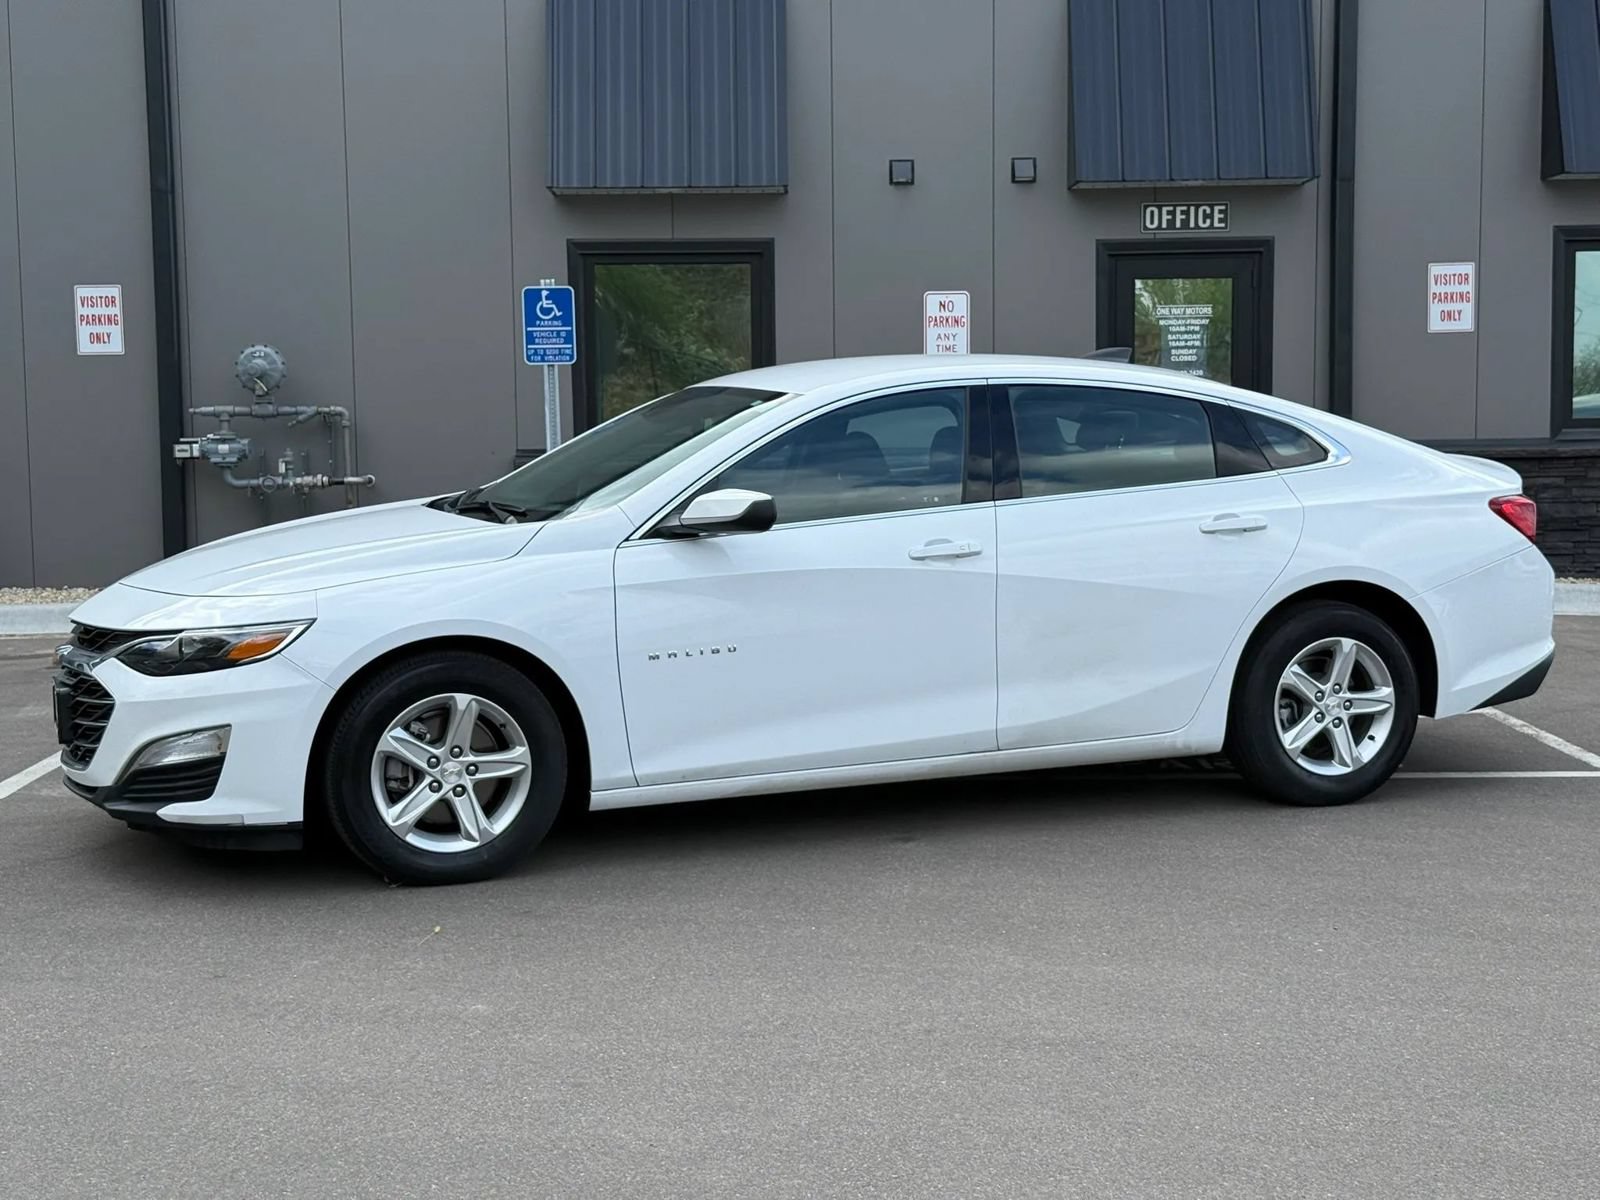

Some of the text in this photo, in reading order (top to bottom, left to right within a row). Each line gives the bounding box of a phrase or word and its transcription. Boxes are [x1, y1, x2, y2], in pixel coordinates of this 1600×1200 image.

[1145, 205, 1226, 229] OFFICE
[1433, 273, 1470, 286] VISITOR
[79, 295, 117, 309] VISITOR
[1432, 291, 1471, 304] PARKING
[939, 300, 955, 313] NO
[1156, 306, 1212, 316] ONE WAY MOTORS
[79, 313, 120, 327] PARKING
[927, 315, 966, 328] PARKING
[1440, 309, 1462, 322] ONLY
[89, 332, 112, 345] ONLY
[935, 333, 958, 341] ANY
[935, 344, 958, 353] TIME
[648, 643, 737, 661] MALIBU
